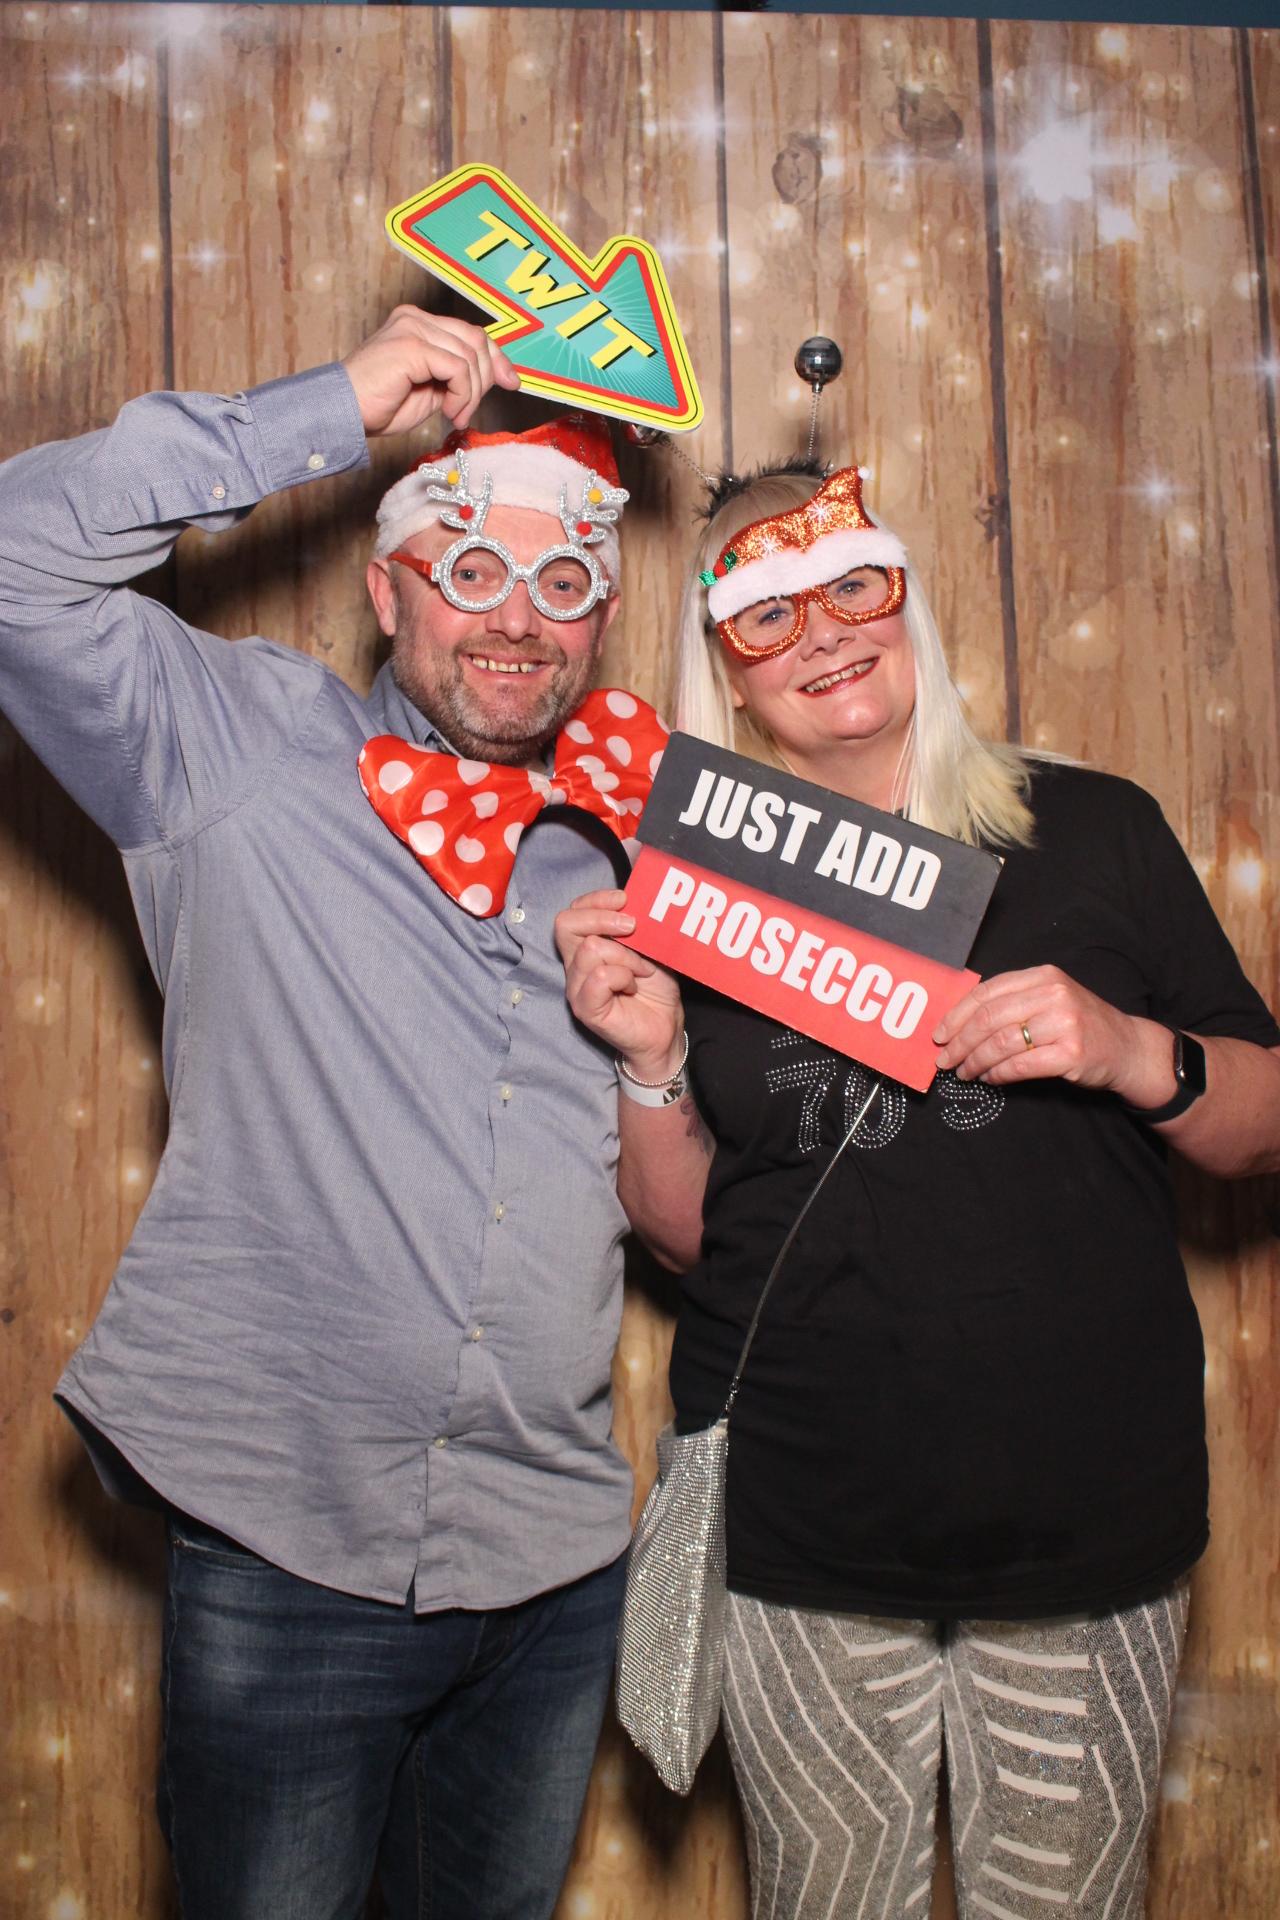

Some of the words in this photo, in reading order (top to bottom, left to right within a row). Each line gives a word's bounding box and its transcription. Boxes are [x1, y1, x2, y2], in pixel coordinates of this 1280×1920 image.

[465, 210, 657, 370] TWIT
[679, 769, 821, 864] JUST
[814, 819, 942, 911] ADD
[648, 866, 928, 1040] PROSECCO
